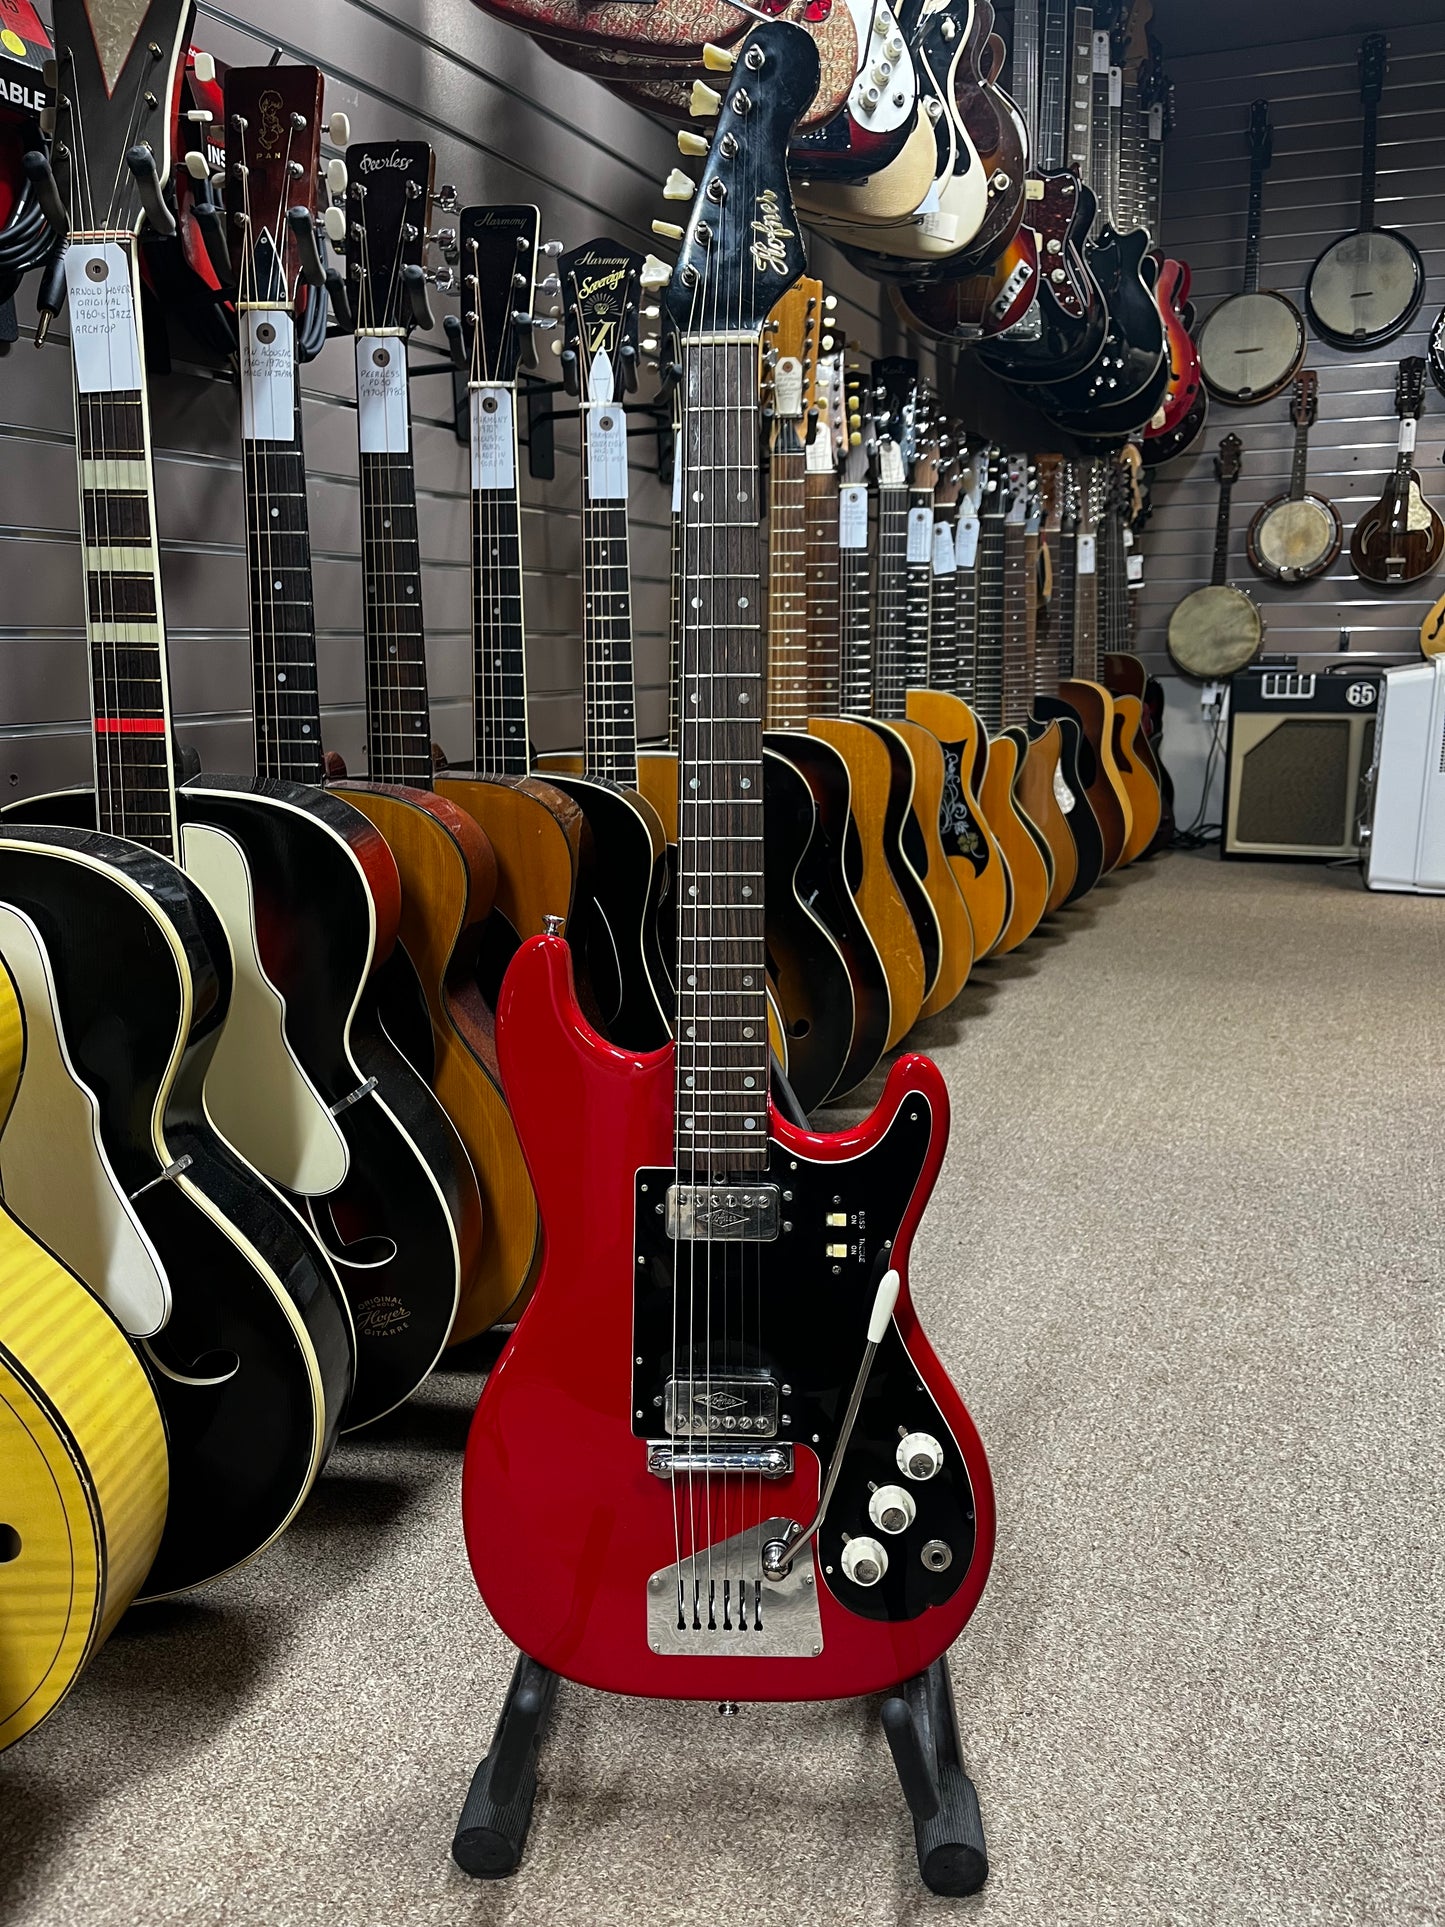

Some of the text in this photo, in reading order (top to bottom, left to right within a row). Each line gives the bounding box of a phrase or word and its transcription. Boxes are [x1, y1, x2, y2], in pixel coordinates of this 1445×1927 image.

[256, 151, 281, 160] PAN
[359, 148, 414, 174] Peerless
[473, 211, 528, 230] Harmony
[574, 251, 631, 269] Harmony
[70, 287, 102, 296] ARNOLD
[578, 269, 626, 299] Sovereign
[77, 298, 121, 307] ORIGINAL
[109, 308, 132, 319] JAZZ
[1348, 684, 1373, 705] 65
[851, 1214, 858, 1225] ON
[851, 1245, 858, 1256] ON
[358, 1296, 403, 1311] ORIGINAL
[357, 1306, 411, 1331] Hoyer
[364, 1321, 409, 1337] GITARRE
